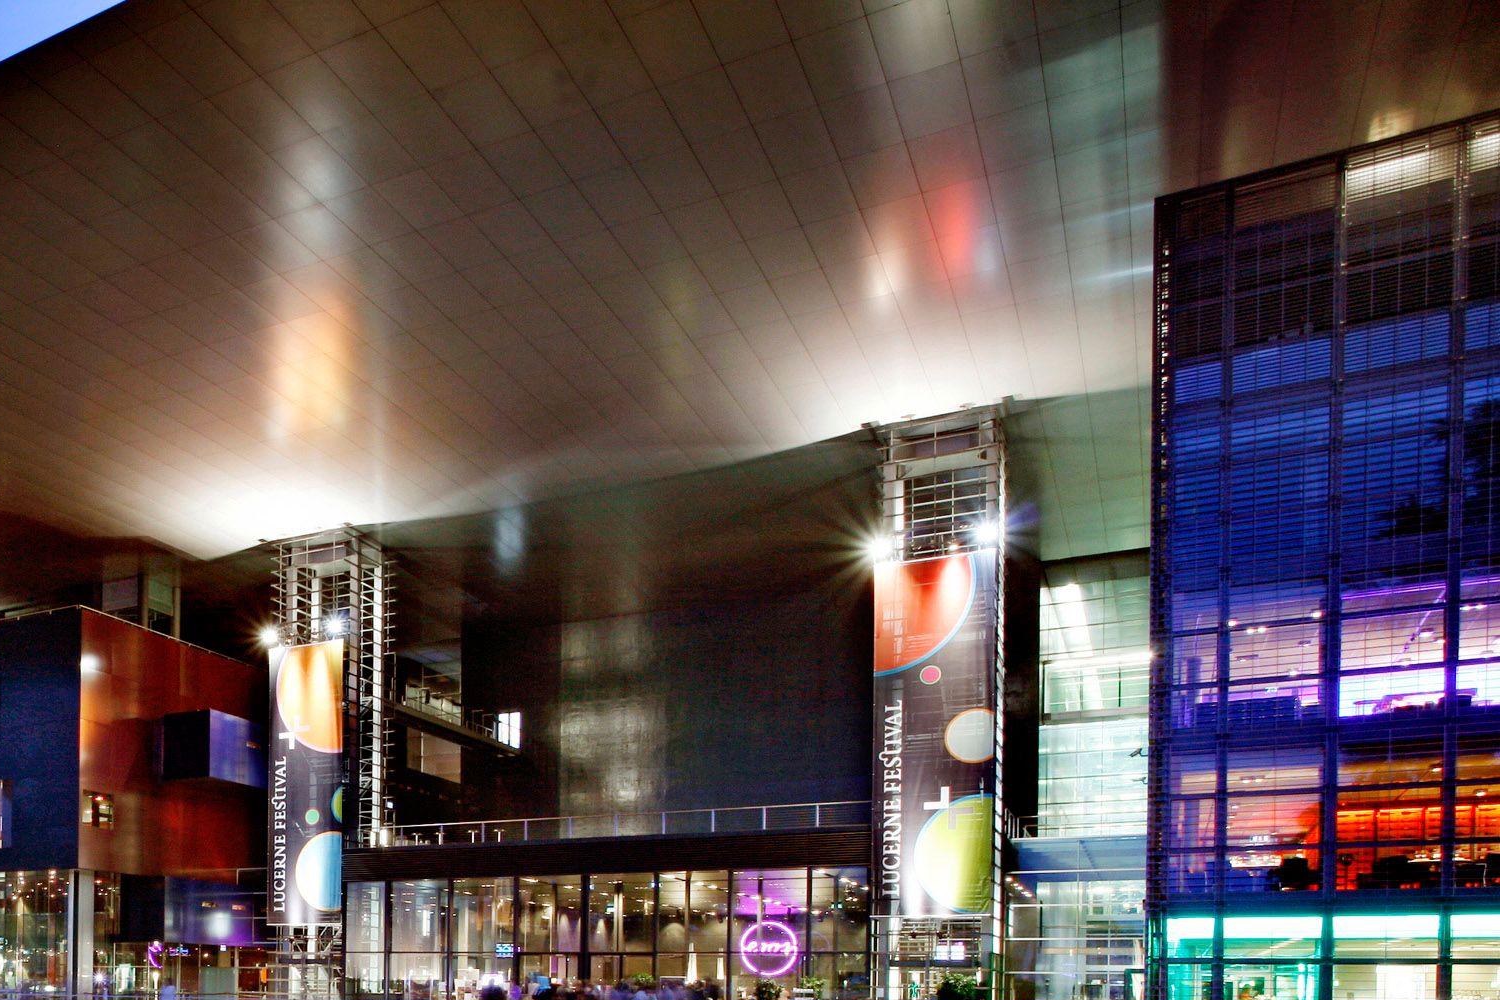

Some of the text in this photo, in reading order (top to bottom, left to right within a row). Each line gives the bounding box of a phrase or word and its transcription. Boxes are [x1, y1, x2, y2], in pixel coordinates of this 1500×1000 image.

[271, 756, 287, 913] LUCERNE FESTIVAL
[878, 699, 903, 896] LUCERNE FESTIVAL
